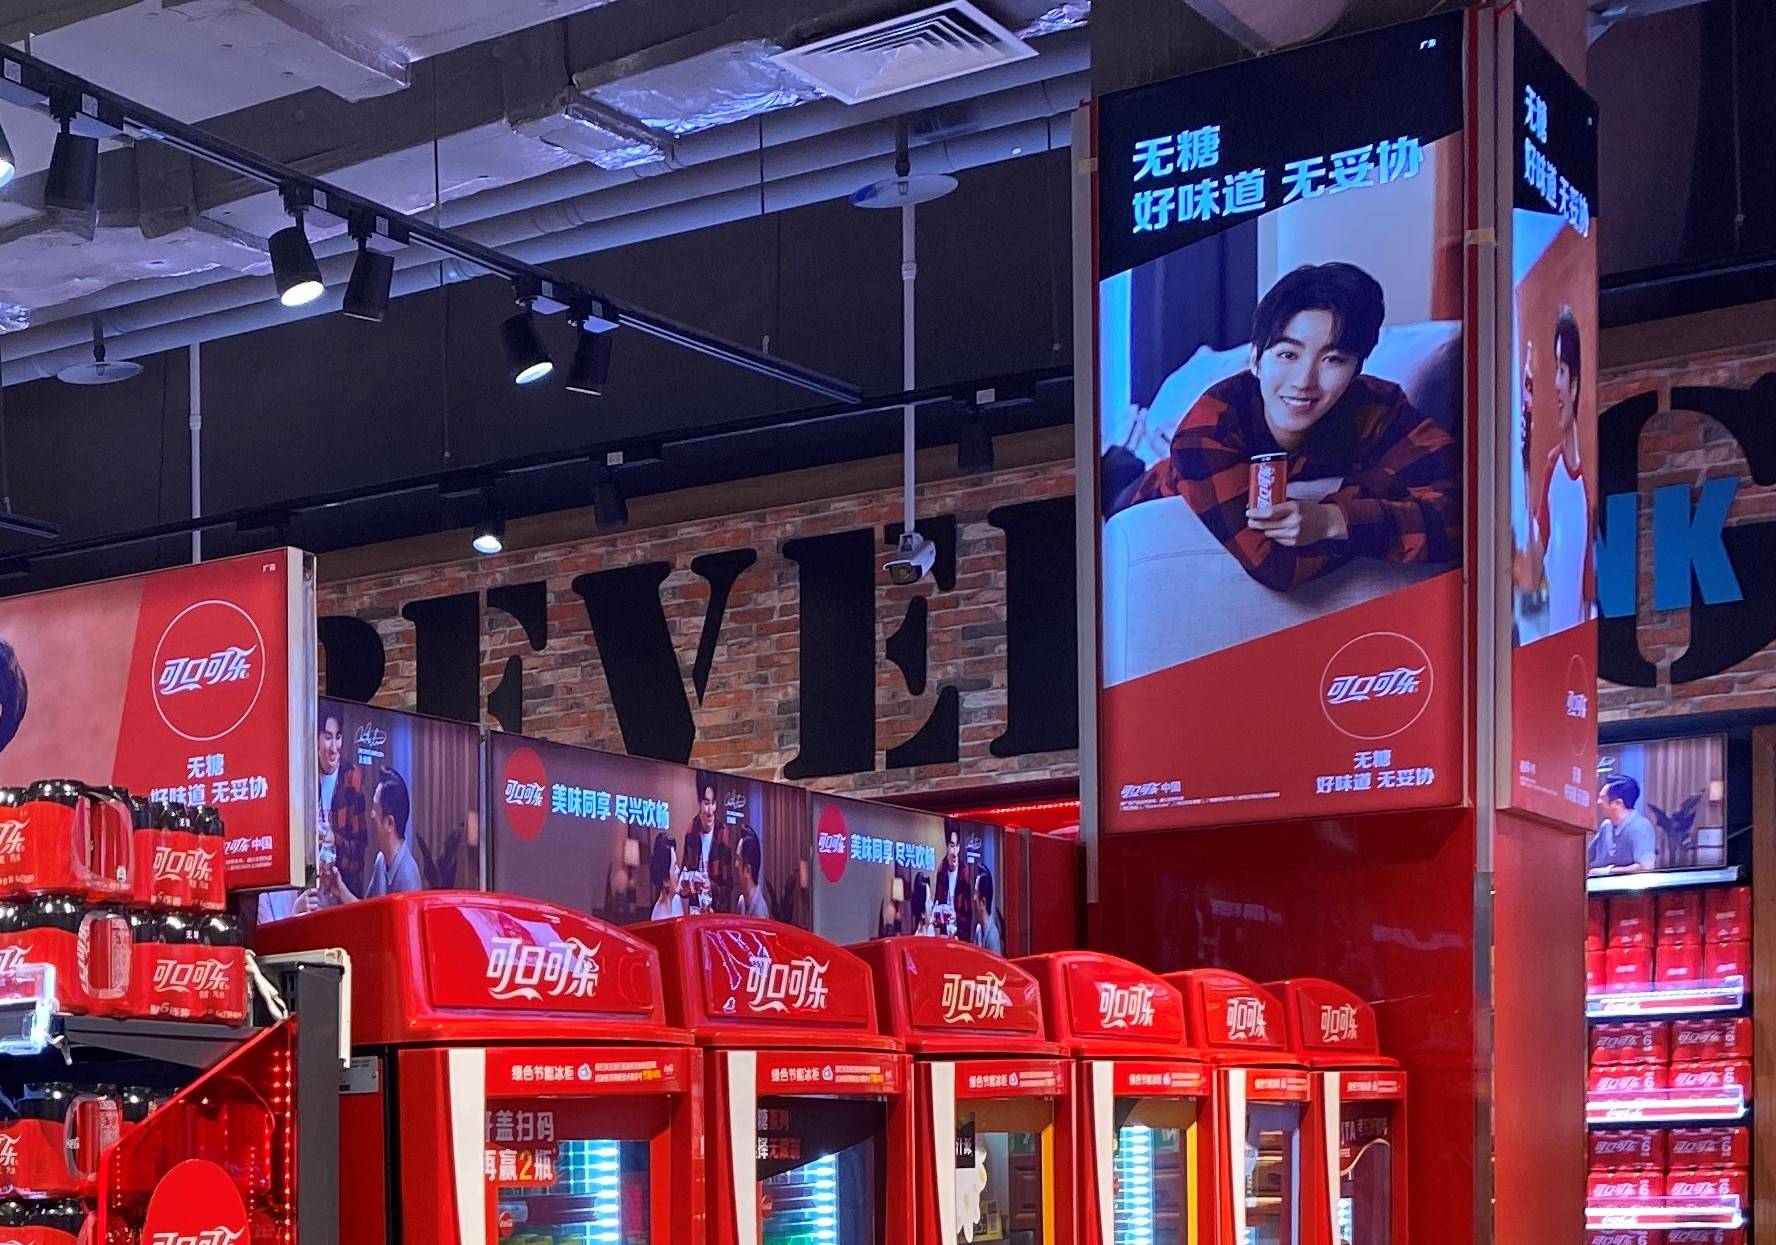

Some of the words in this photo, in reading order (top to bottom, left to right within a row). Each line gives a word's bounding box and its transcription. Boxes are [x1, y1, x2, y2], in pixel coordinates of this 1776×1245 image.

[1525, 85, 1547, 144] 无糖
[1132, 125, 1221, 181] 无糖
[1132, 168, 1266, 233] 好味道
[1281, 136, 1424, 202] 无妥协
[159, 645, 257, 695] 可口可乐
[1327, 667, 1425, 704] 可口可乐
[187, 753, 224, 779] 无糖
[1354, 750, 1392, 768] 无糖
[151, 784, 206, 807] 好味道
[211, 776, 269, 804] 无妥协
[505, 779, 546, 807] 可口可乐
[1316, 774, 1371, 794] 好味道
[1377, 767, 1434, 788] 无妥协
[552, 783, 612, 820] 美味同享
[615, 793, 670, 830] 尽兴欢畅
[818, 830, 846, 854] 可口可乐
[850, 834, 893, 865] 美味同享
[896, 839, 936, 871] 尽兴欢畅
[153, 846, 216, 880] 可口可乐
[153, 960, 233, 993] 可口可乐
[486, 937, 601, 1000] 可口可乐
[746, 956, 830, 1012] 可口可乐
[942, 972, 1007, 1022] 可口可乐
[1099, 983, 1155, 1029] 可口可乐
[1225, 997, 1266, 1040] 可口可乐
[1320, 1003, 1359, 1042] 可口可乐
[512, 1065, 574, 1081] 绿色节能冰柜
[771, 1068, 820, 1082] 绿色节能冰柜
